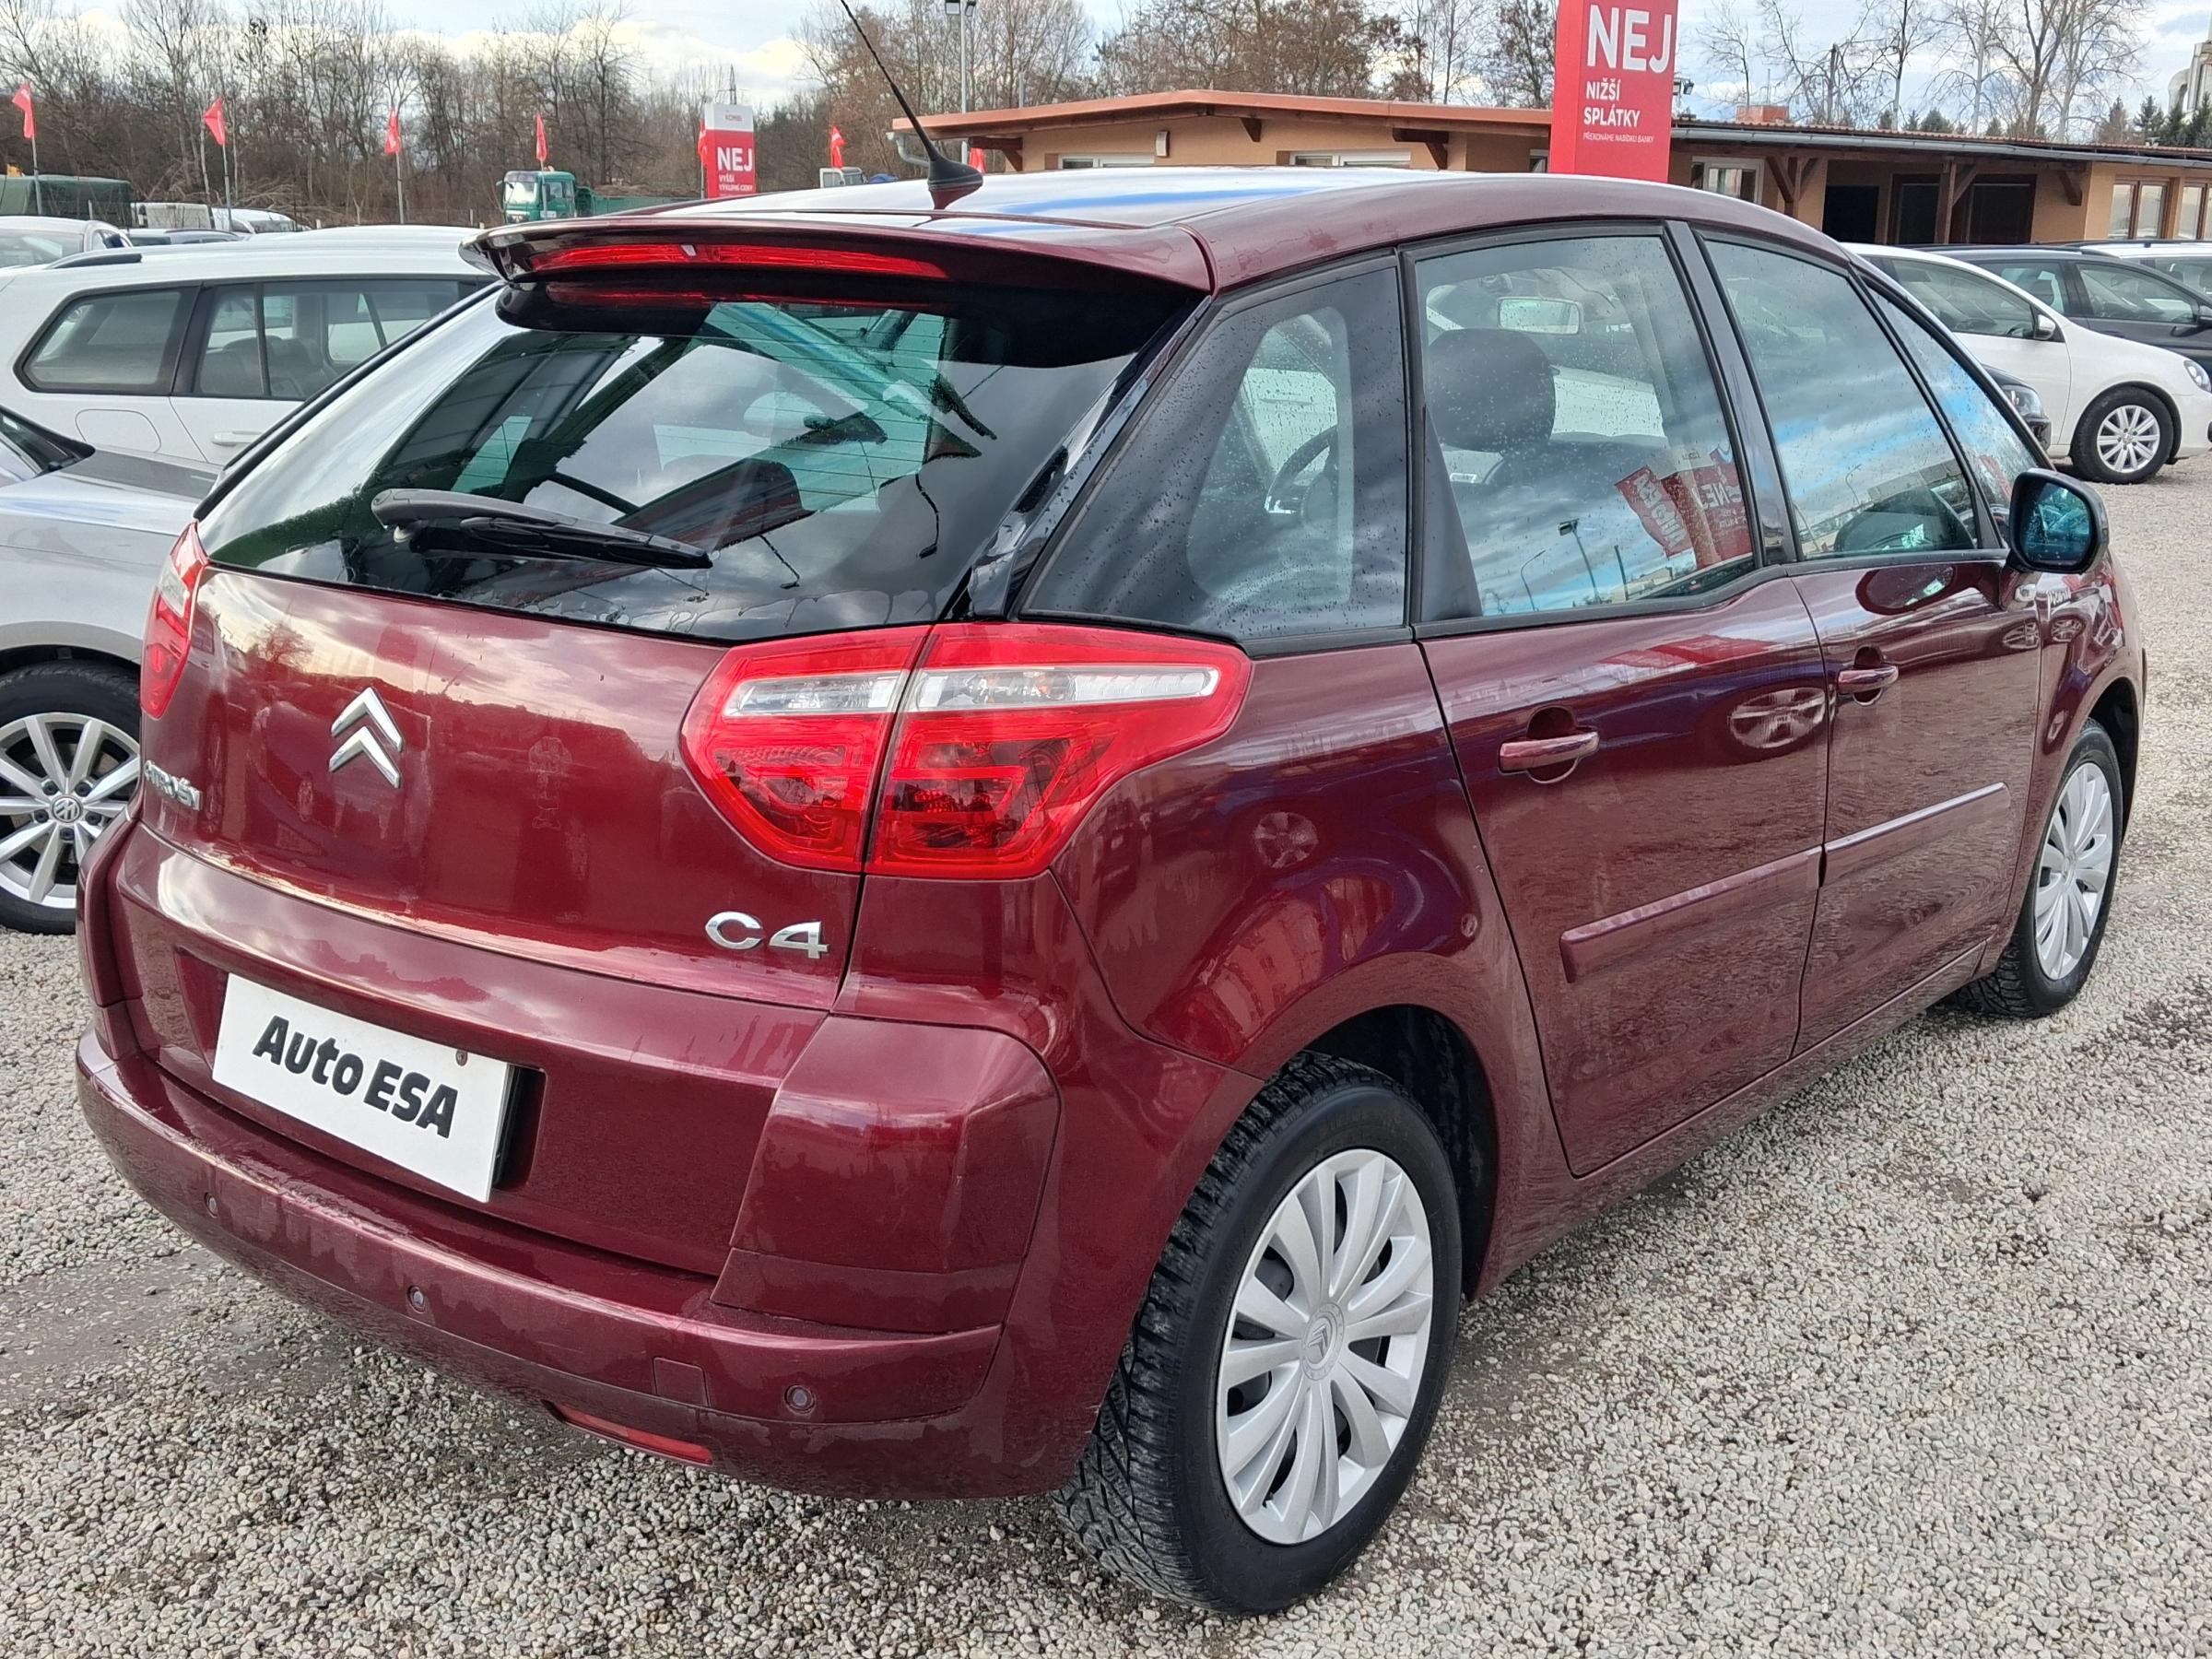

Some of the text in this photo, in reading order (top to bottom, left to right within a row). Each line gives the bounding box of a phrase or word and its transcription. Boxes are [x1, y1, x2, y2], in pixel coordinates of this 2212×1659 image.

[1586, 4, 1673, 74] NEJ
[1585, 77, 1621, 101] NIŽŠÍ
[1583, 104, 1641, 127] SPLÁTKY
[717, 147, 753, 171] NEJ
[252, 1015, 458, 1139] Auto ESA
